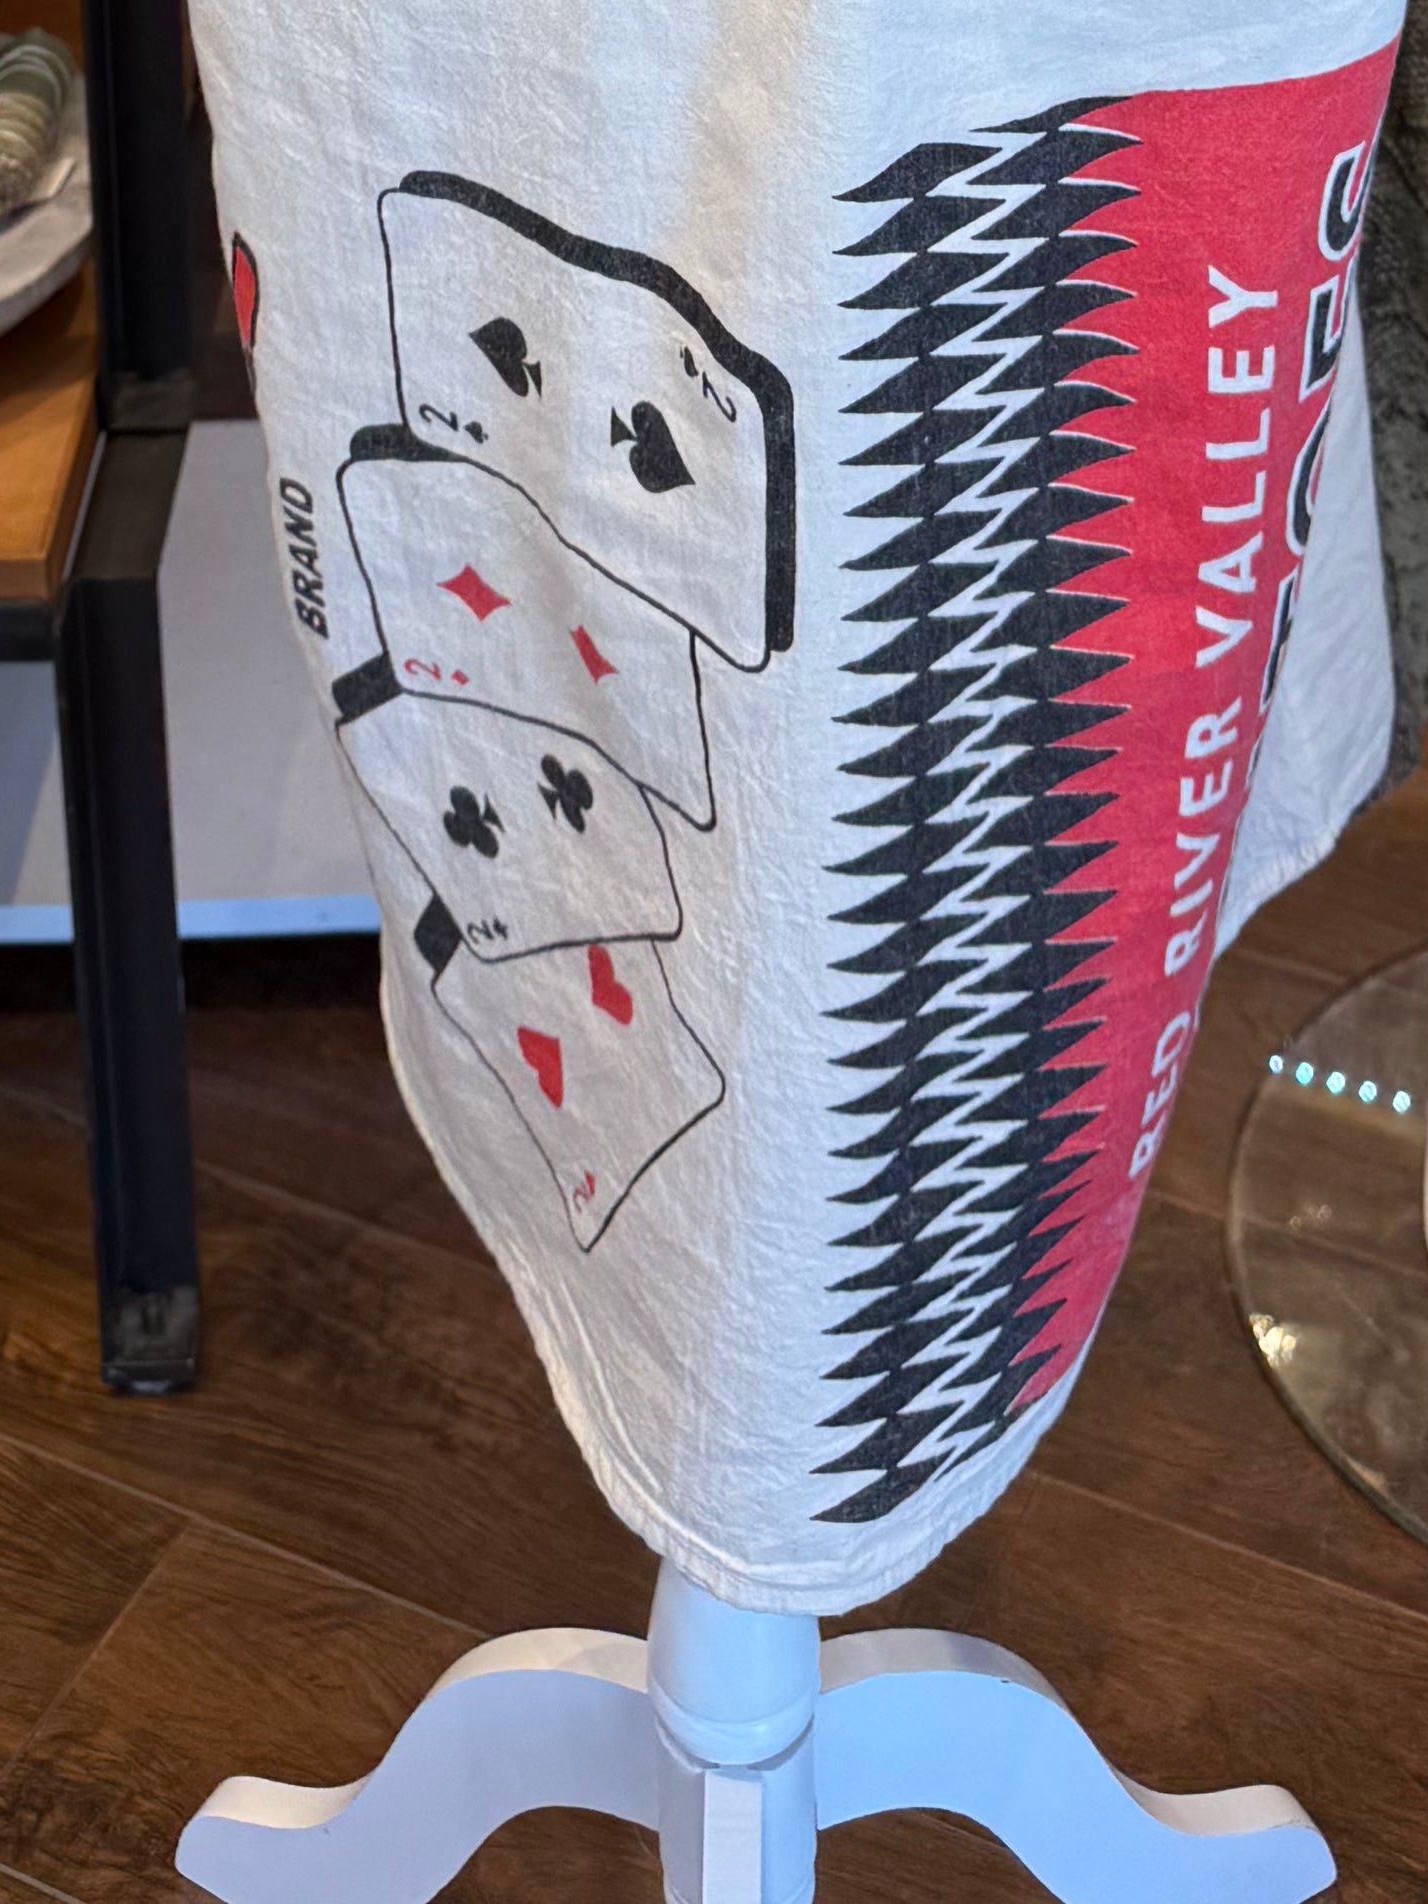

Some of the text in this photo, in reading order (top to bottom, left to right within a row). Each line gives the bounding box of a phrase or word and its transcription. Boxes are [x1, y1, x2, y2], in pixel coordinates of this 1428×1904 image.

[280, 478, 331, 641] BRAND
[1194, 263, 1278, 671] VALLEY
[1163, 695, 1243, 978] RIVER
